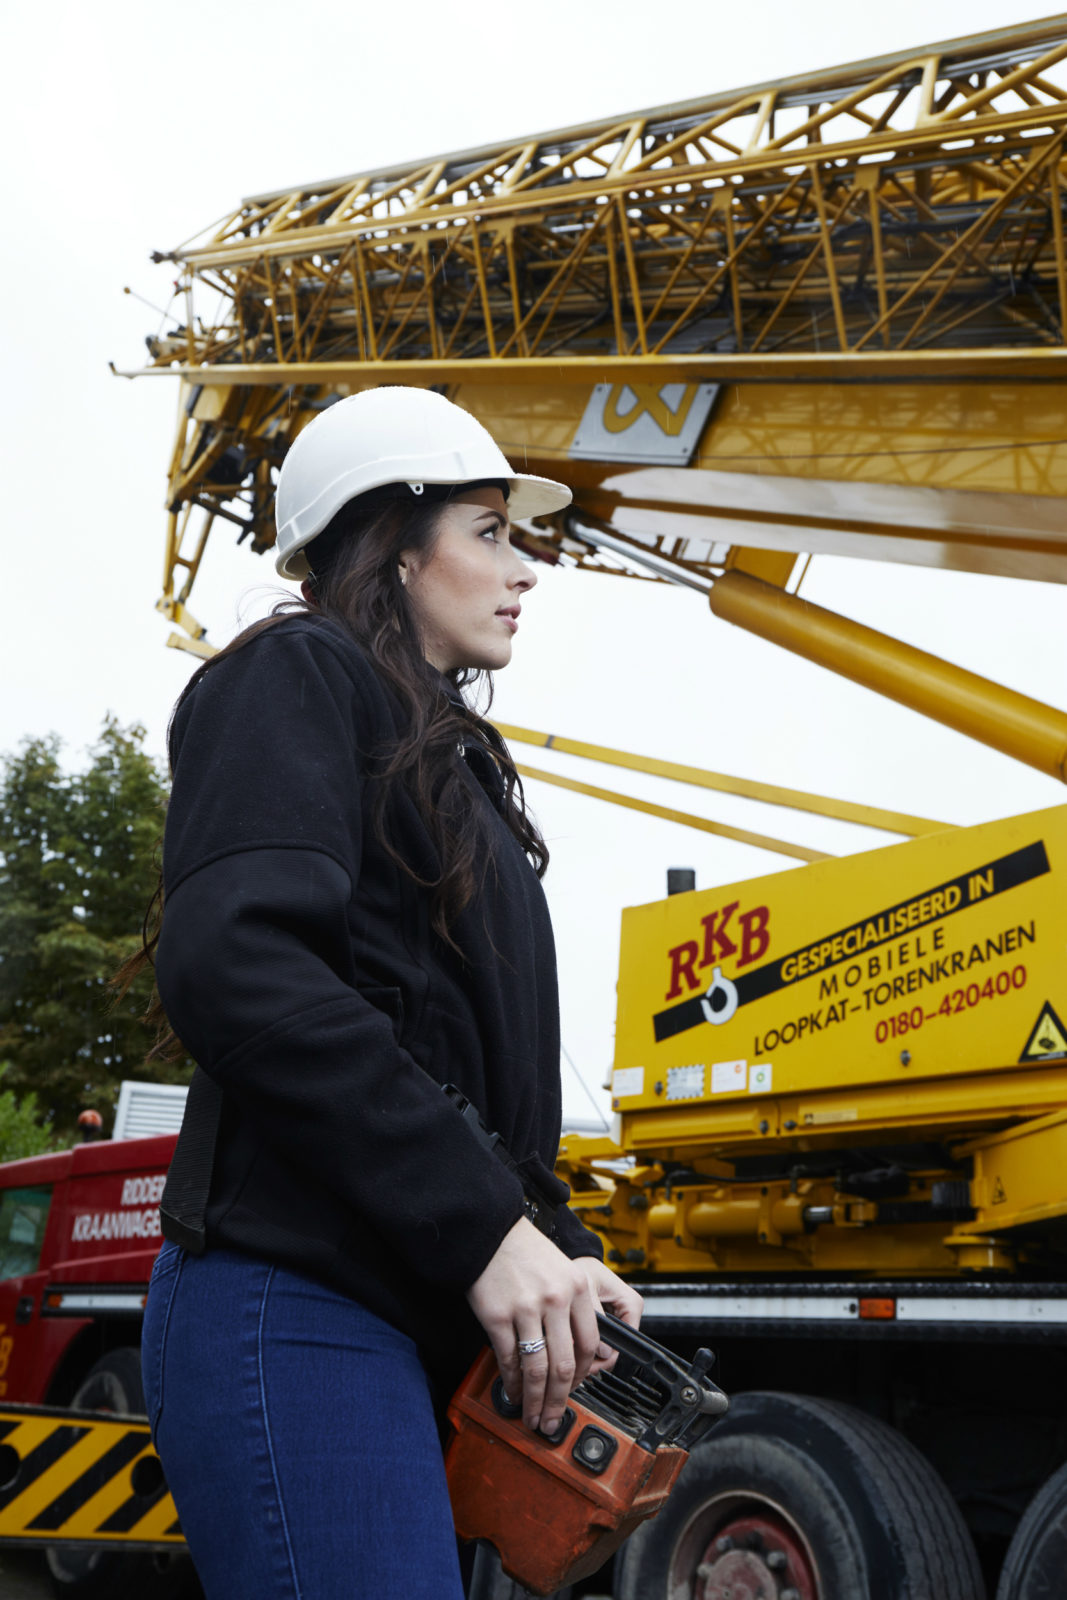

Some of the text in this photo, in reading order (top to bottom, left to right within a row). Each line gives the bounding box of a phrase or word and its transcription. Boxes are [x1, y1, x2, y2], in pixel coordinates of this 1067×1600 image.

[665, 900, 770, 1002] RKB
[780, 868, 995, 983] GESPECIALISEERD IN
[819, 926, 945, 1001] MOBIELE
[754, 919, 1036, 1057] LOOPKAT-TORENKRANEN
[875, 964, 1027, 1044] 0180-420400
